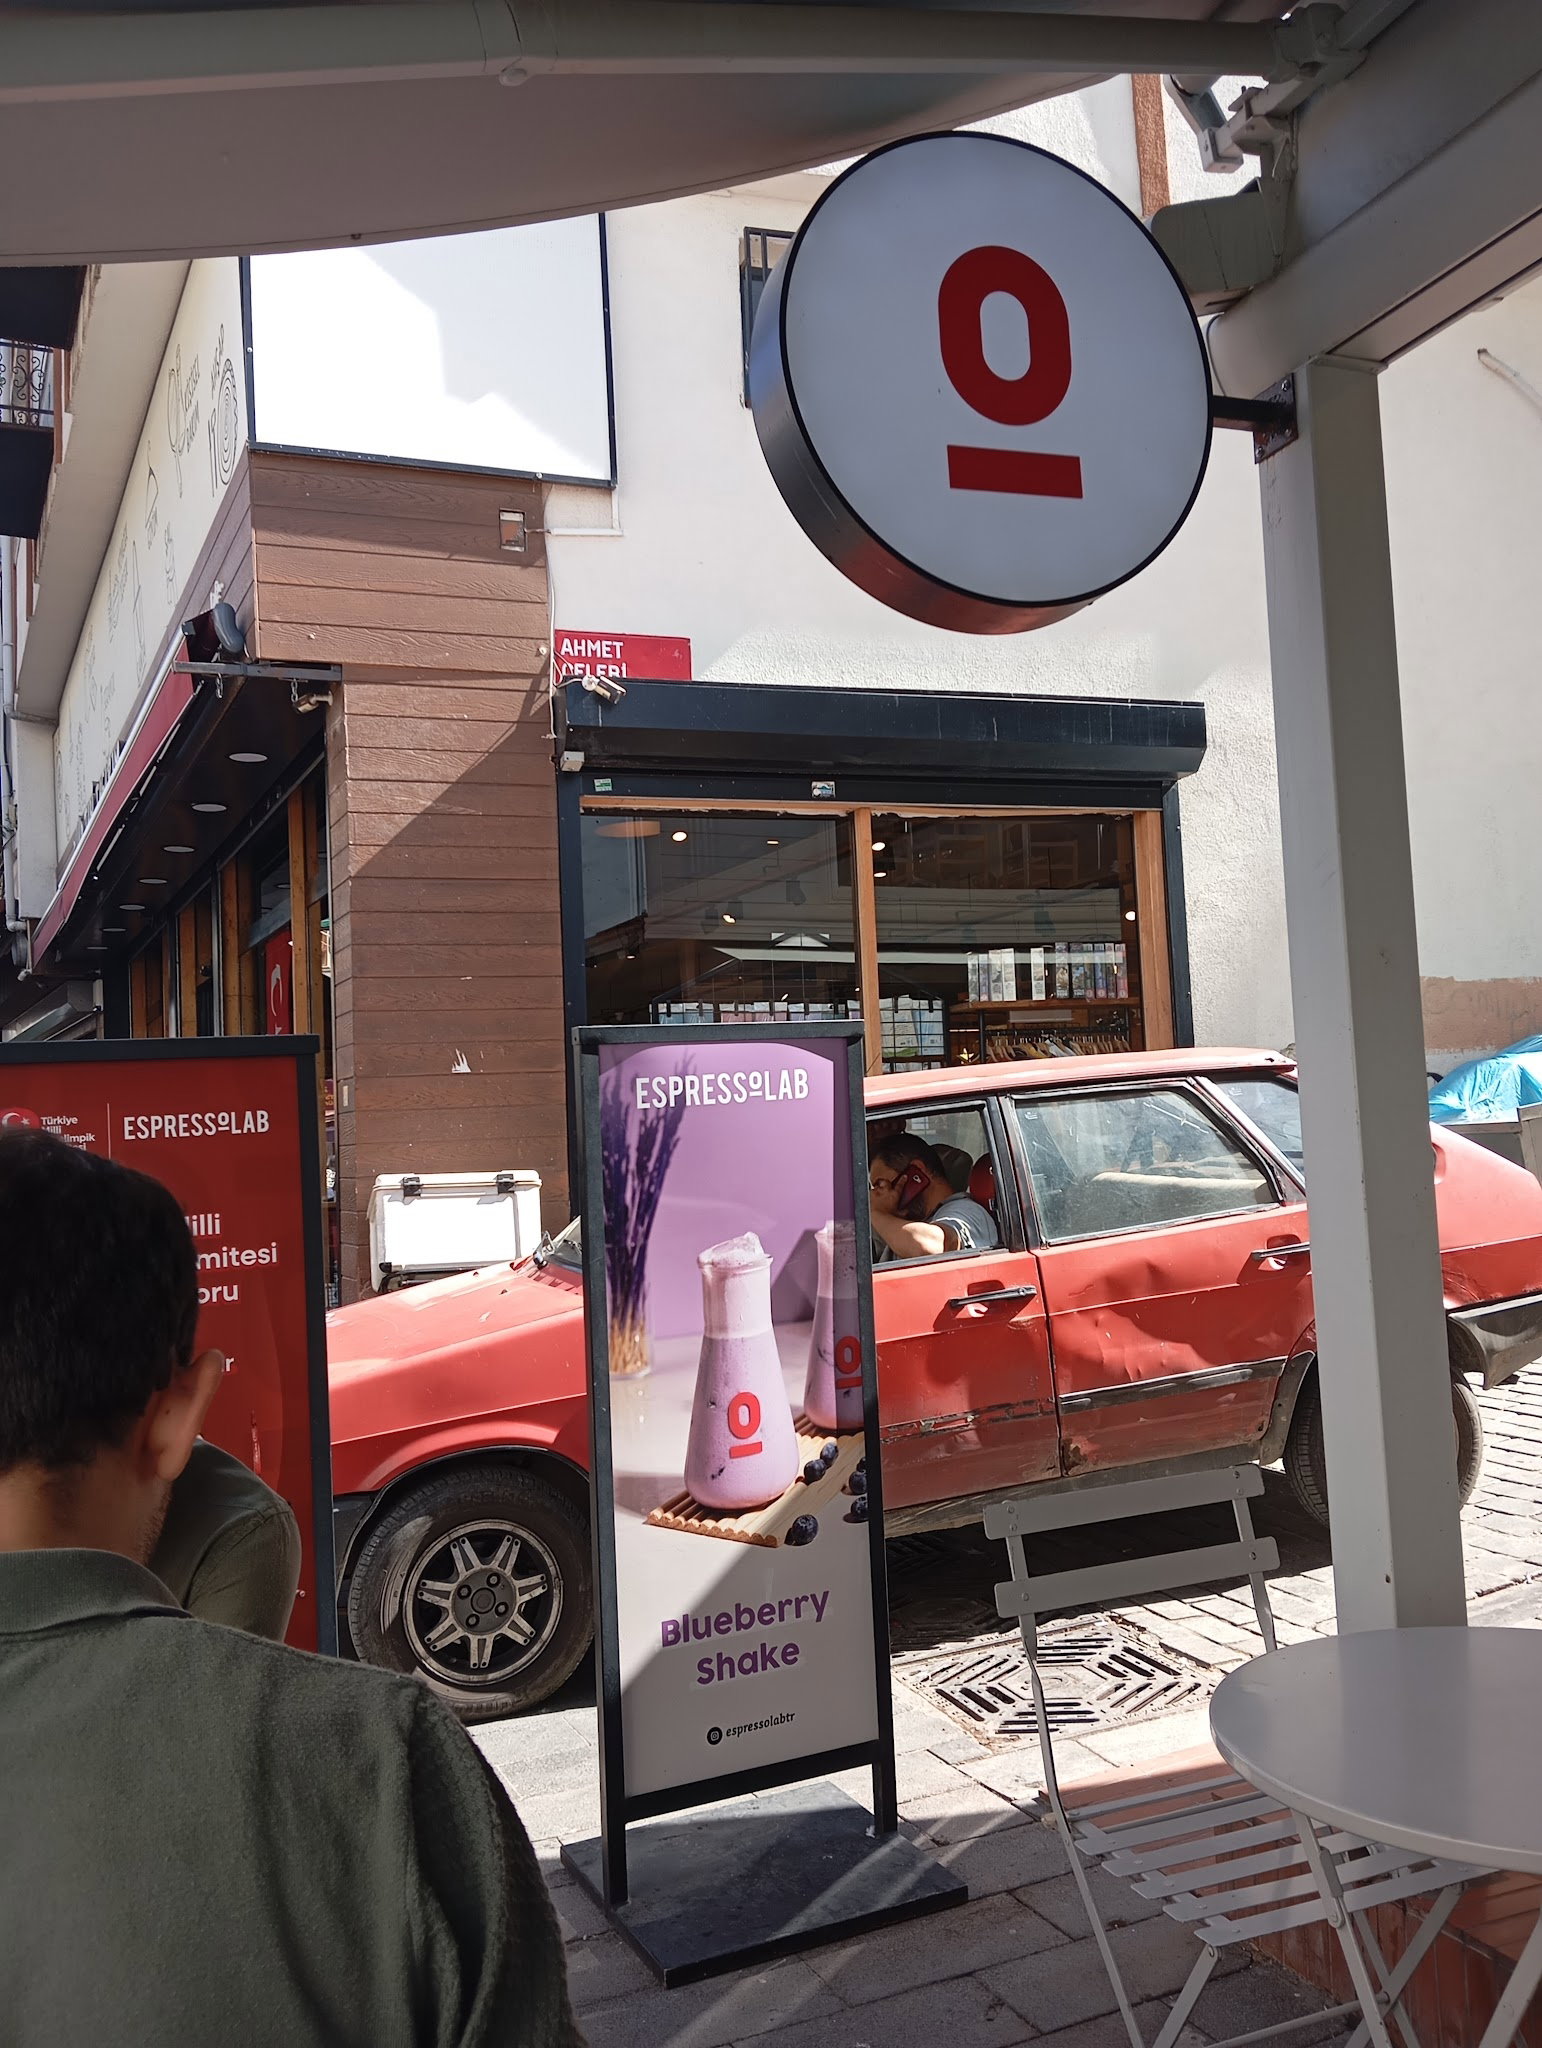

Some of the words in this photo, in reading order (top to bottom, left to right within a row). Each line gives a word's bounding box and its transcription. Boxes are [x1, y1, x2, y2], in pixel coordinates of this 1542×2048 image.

[560, 637, 624, 660] AHMET
[40, 1115, 79, 1127] Türkiye
[195, 1241, 279, 1271] mitesi
[660, 1590, 830, 1648] Blueberry
[696, 1642, 801, 1685] Shake
[725, 1711, 796, 1738] espressolabtr
